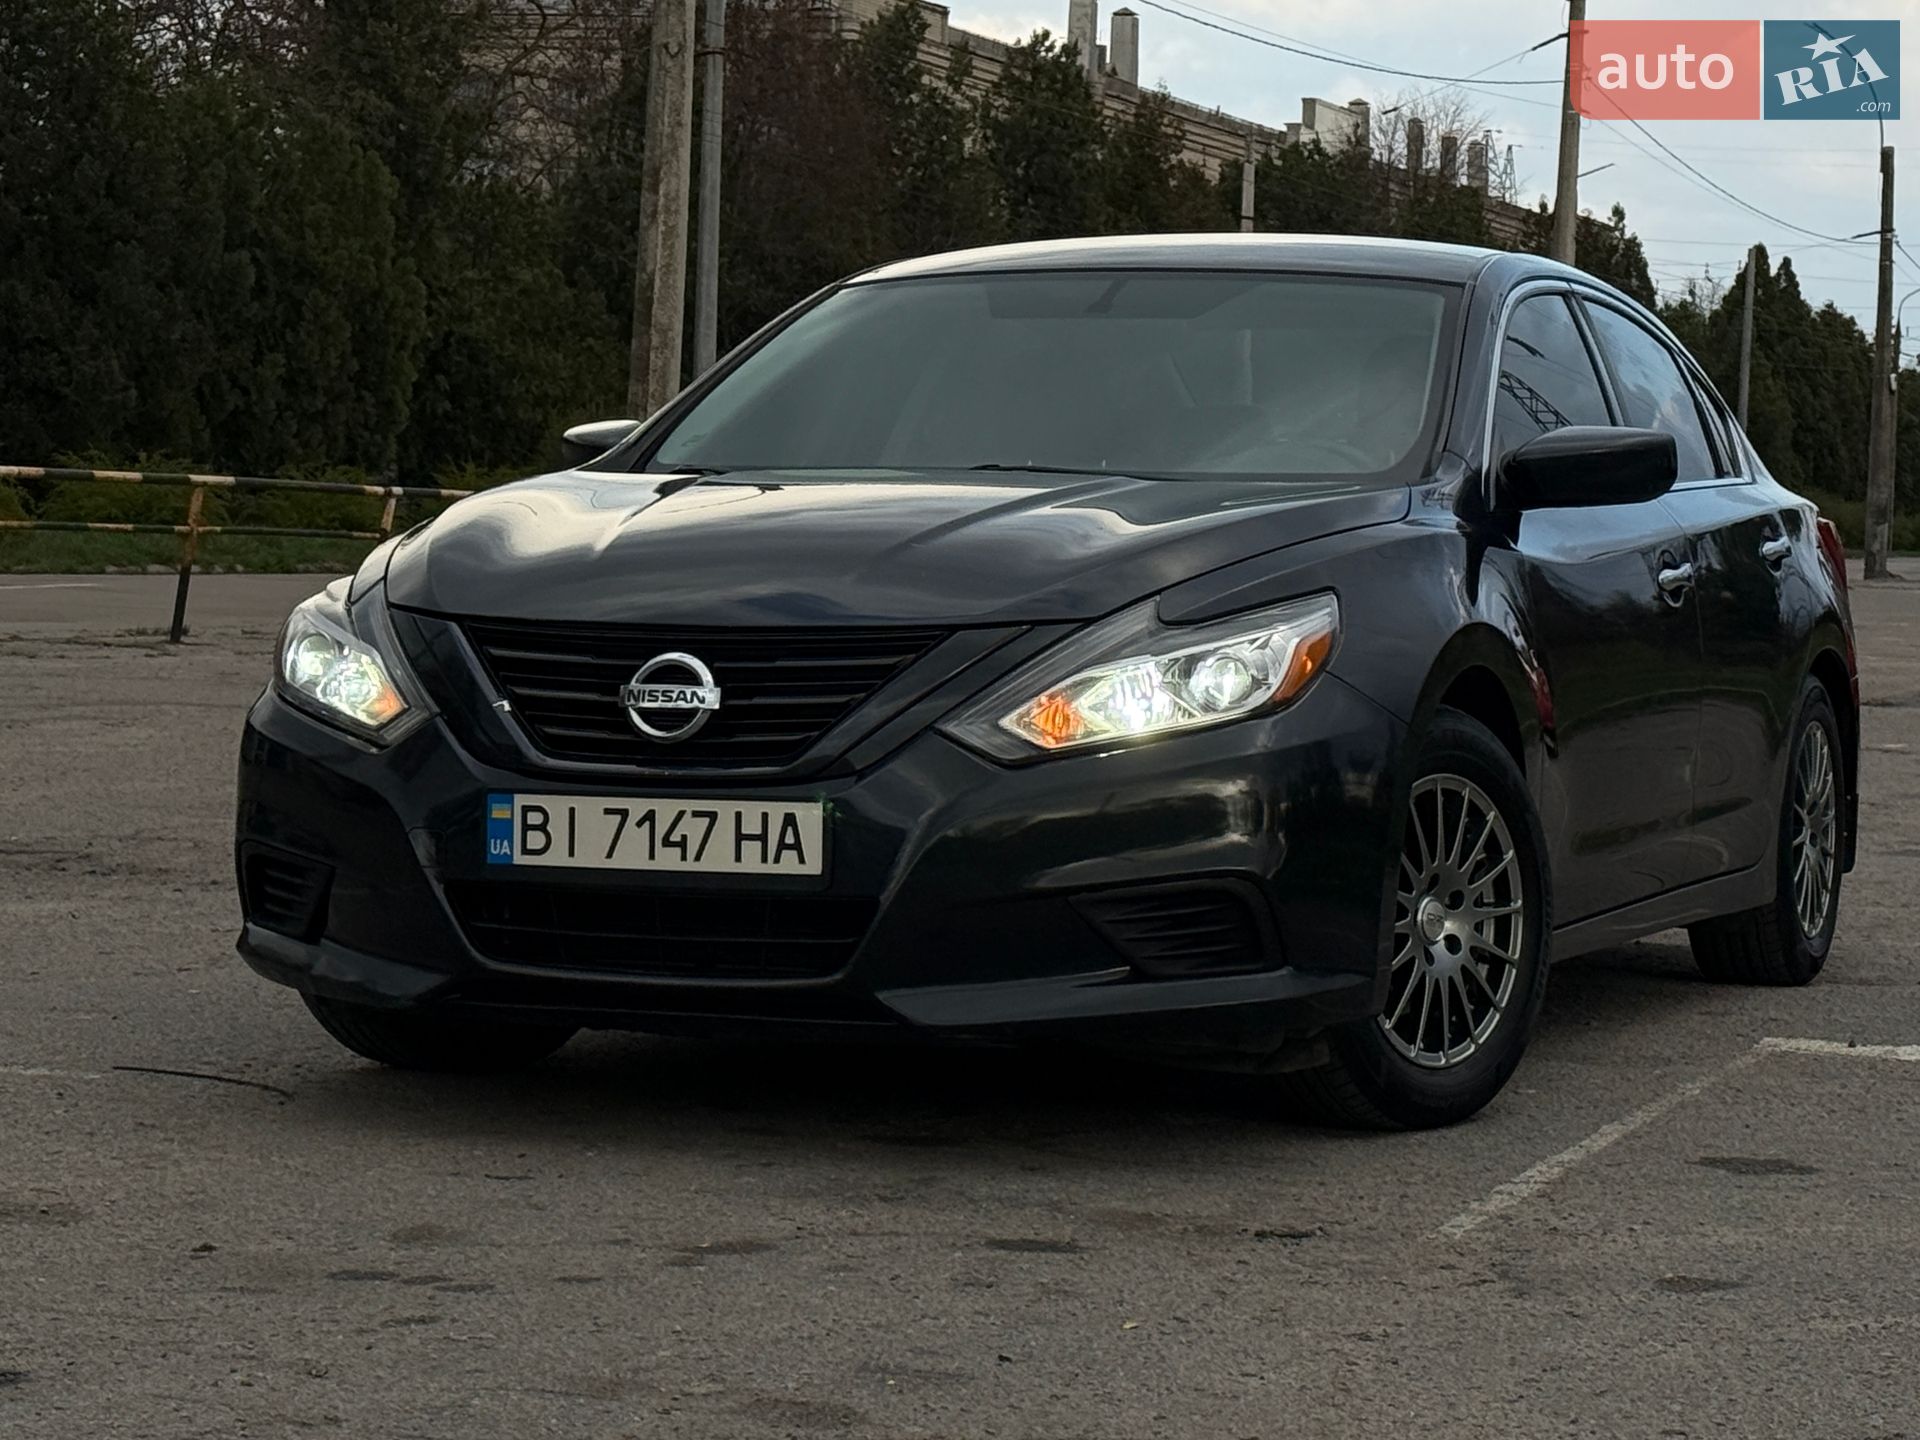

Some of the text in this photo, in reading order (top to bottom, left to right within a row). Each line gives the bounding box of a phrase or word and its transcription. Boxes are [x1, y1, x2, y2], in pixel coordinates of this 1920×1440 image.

[626, 688, 706, 705] NISSAN
[521, 805, 806, 864] BI 7147 HA
[490, 838, 511, 855] UA
